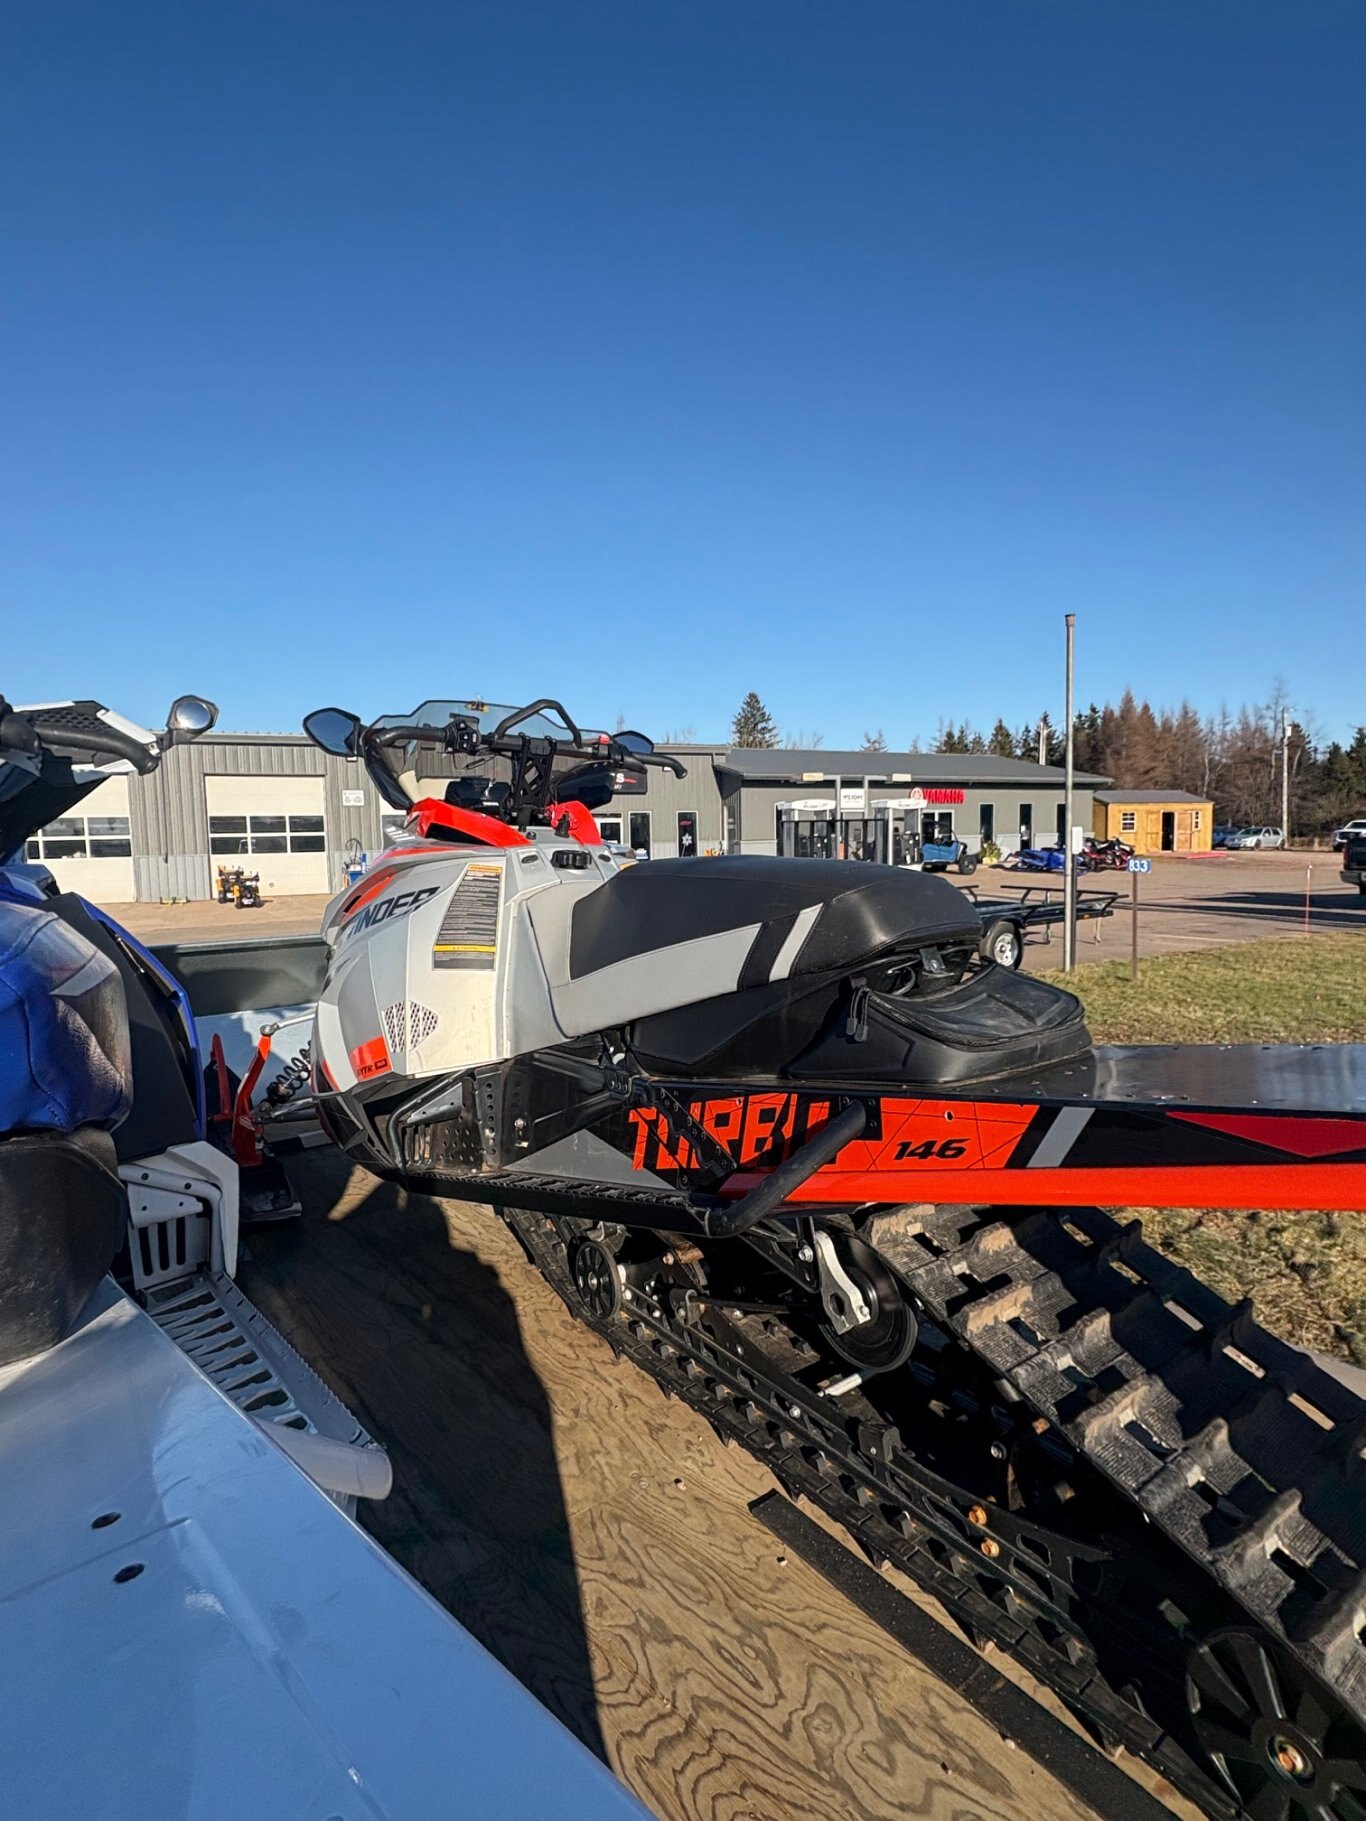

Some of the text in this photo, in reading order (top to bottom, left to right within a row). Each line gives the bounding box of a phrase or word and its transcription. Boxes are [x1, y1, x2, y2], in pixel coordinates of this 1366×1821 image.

[923, 788, 965, 805] YAMAHA
[1128, 859, 1148, 872] 833
[894, 1138, 971, 1160] 146
